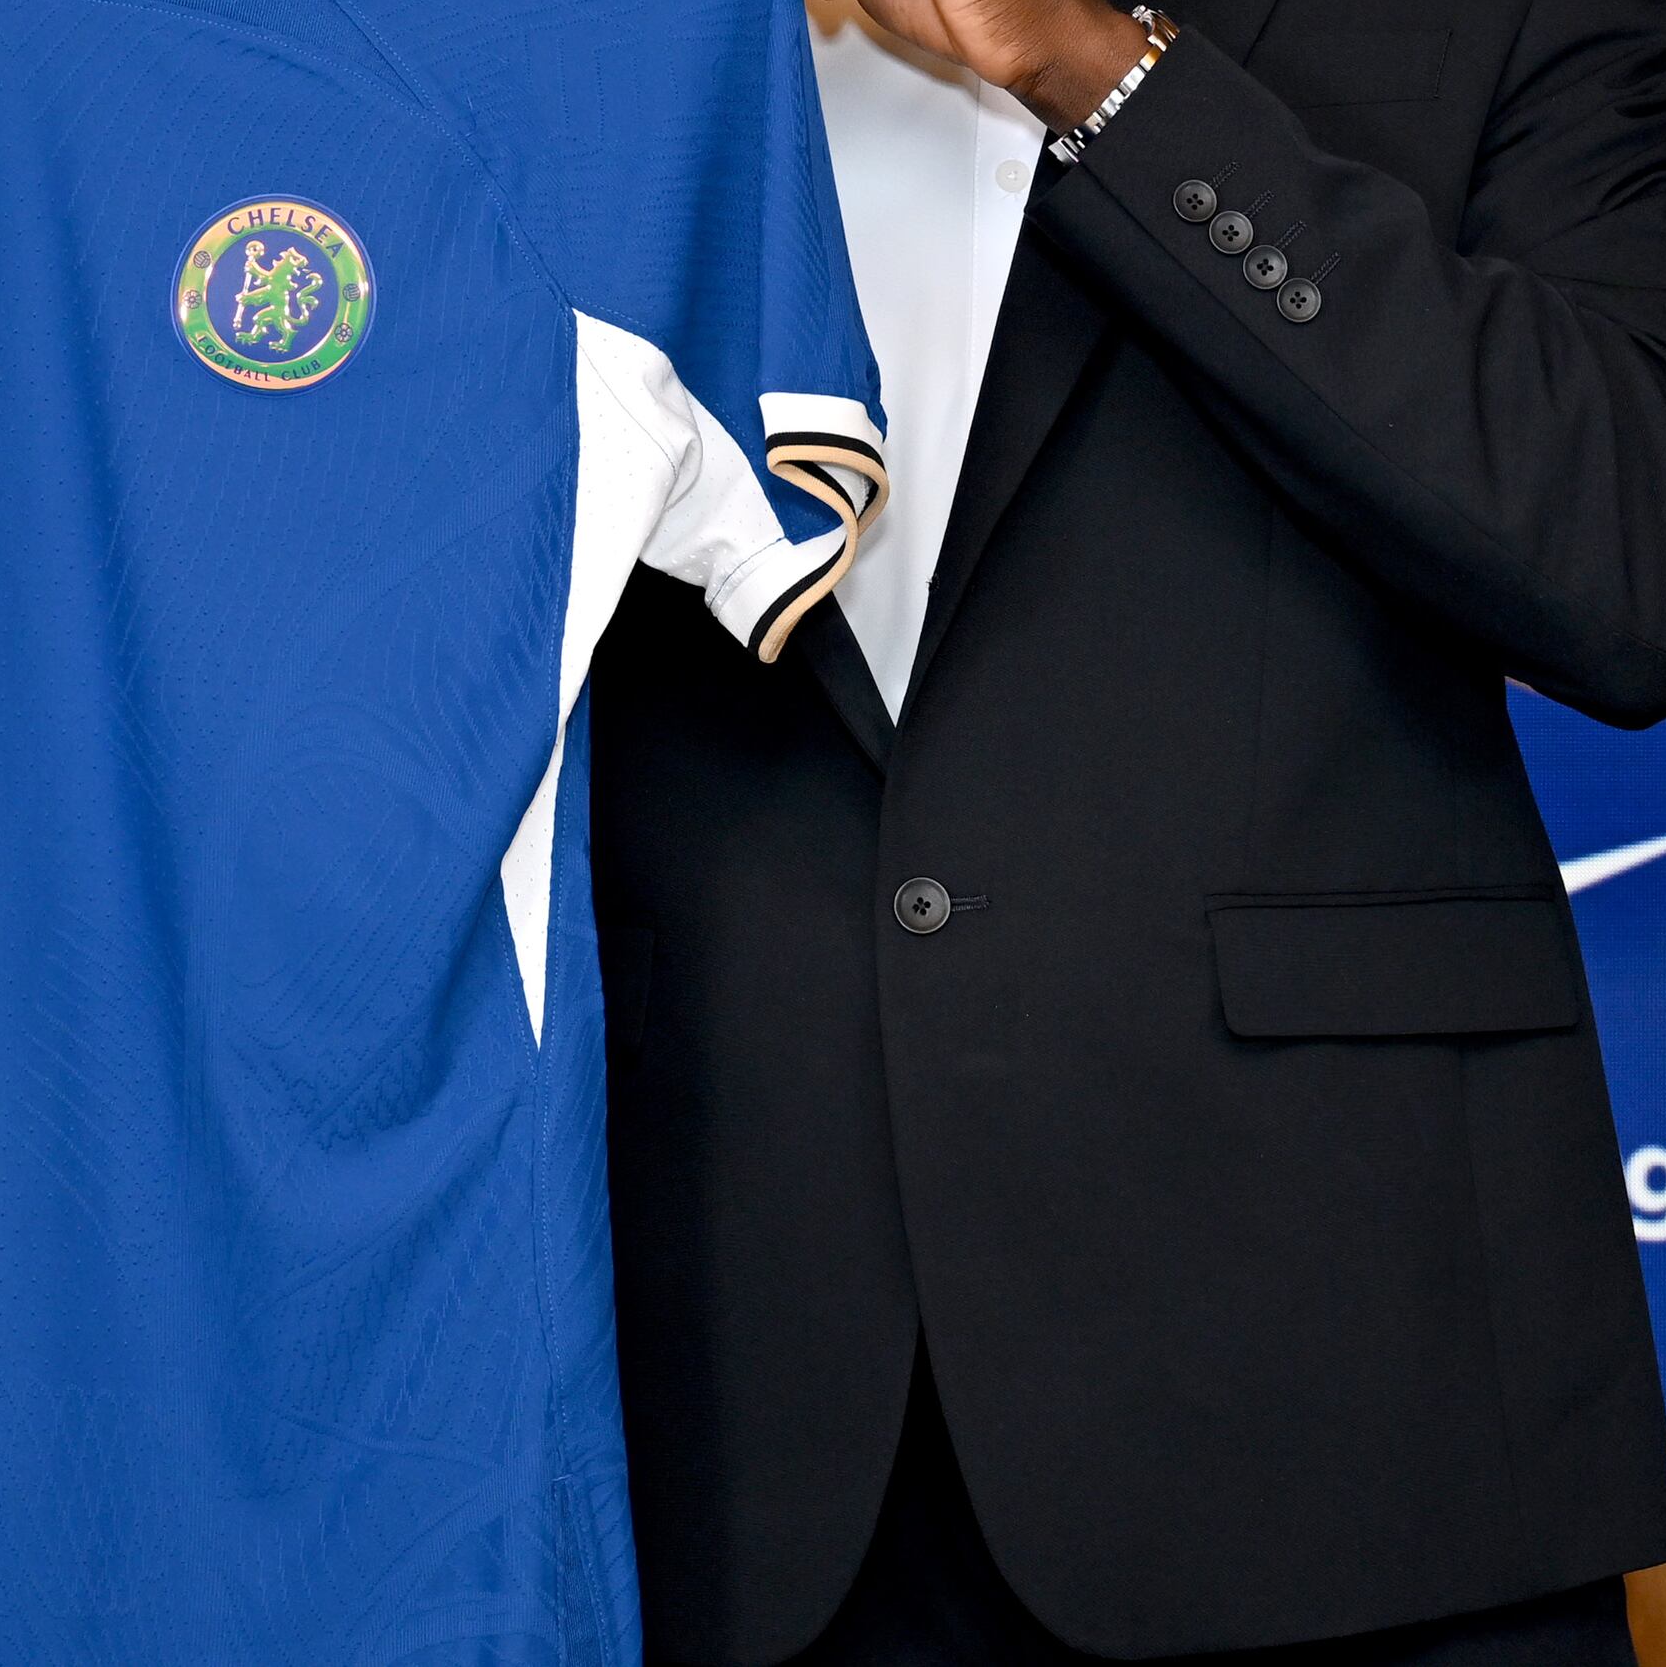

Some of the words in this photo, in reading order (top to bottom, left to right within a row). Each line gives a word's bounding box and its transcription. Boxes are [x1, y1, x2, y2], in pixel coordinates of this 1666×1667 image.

[227, 207, 345, 259] CHELSEA
[197, 335, 271, 382] FOOTBALL
[281, 359, 322, 381] CLUB
